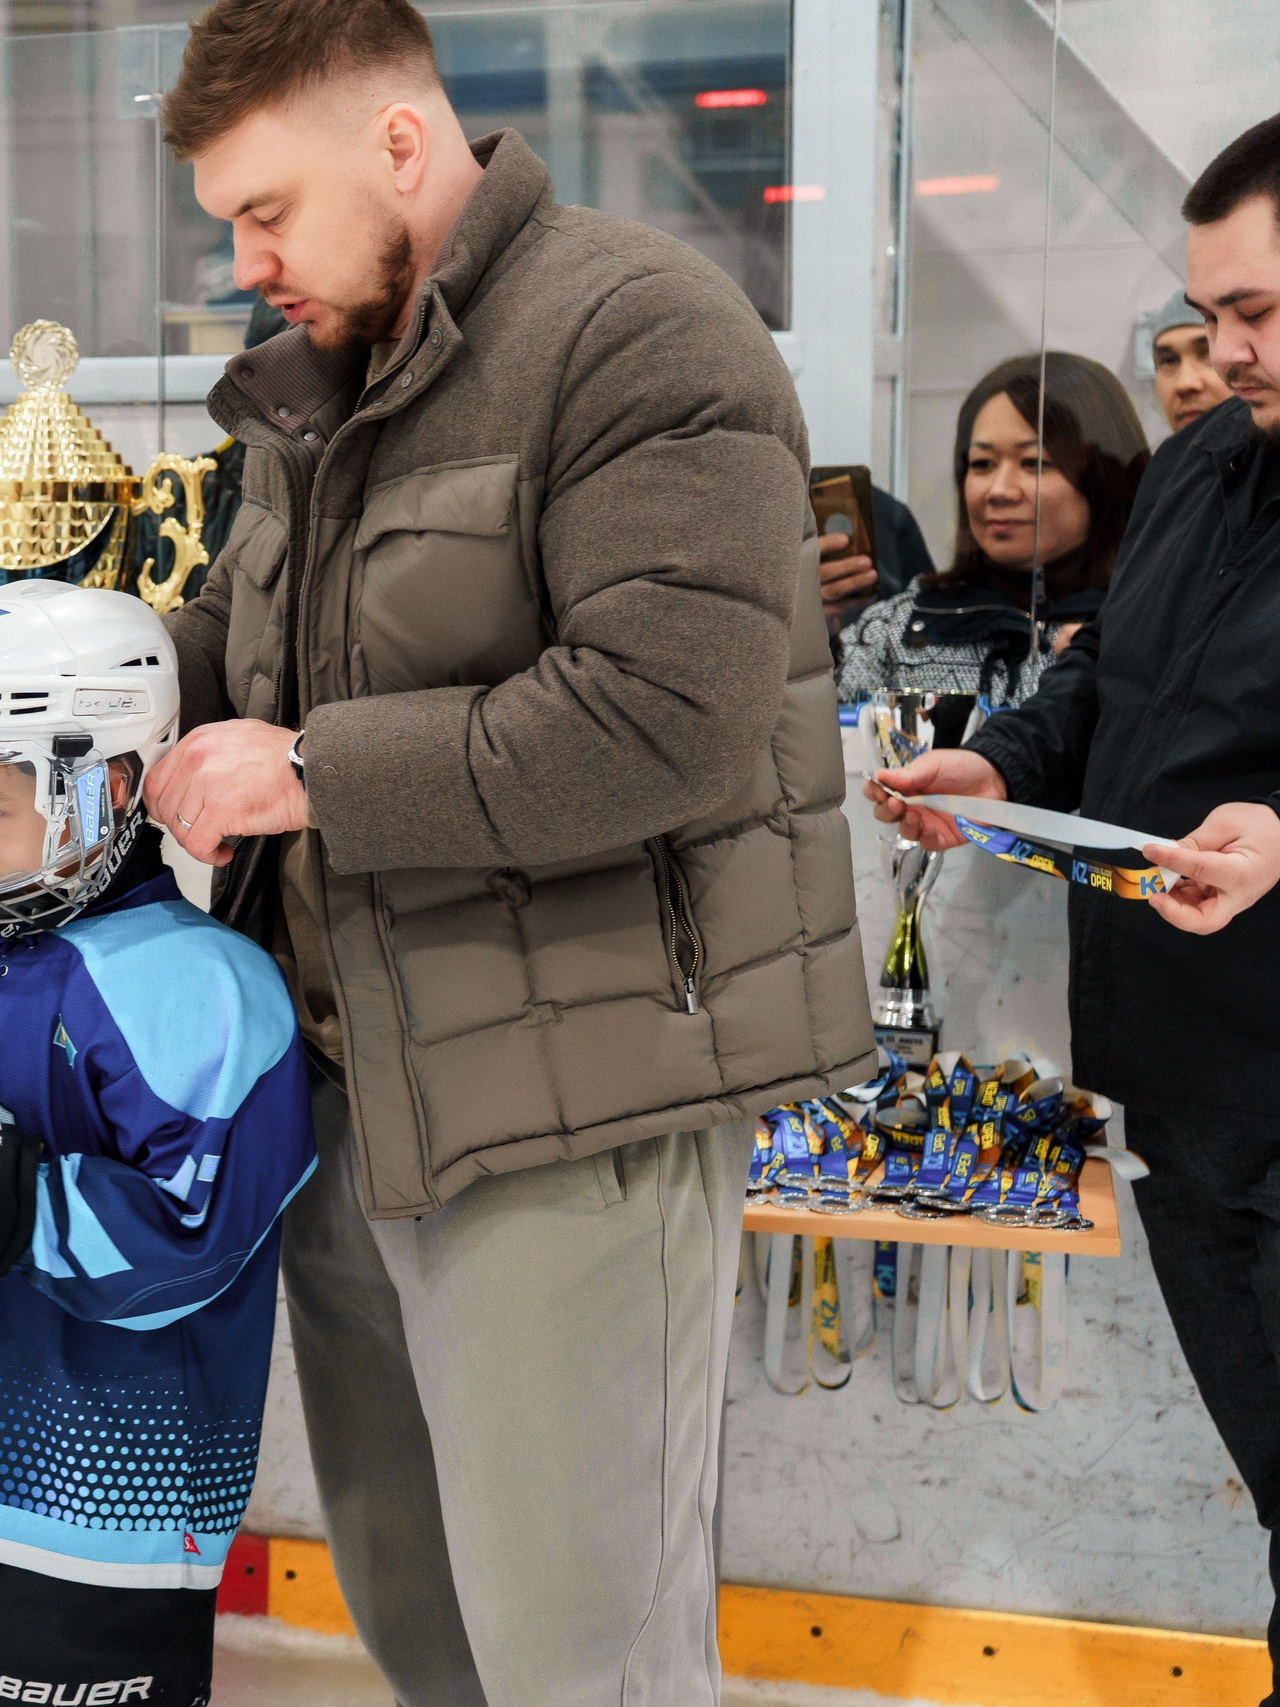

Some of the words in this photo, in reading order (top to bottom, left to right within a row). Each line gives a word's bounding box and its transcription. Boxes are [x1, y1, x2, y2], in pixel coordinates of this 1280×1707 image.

[85, 773, 97, 842] BAUER
[1071, 859, 1088, 885] KZ
[1090, 873, 1113, 892] OPEN
